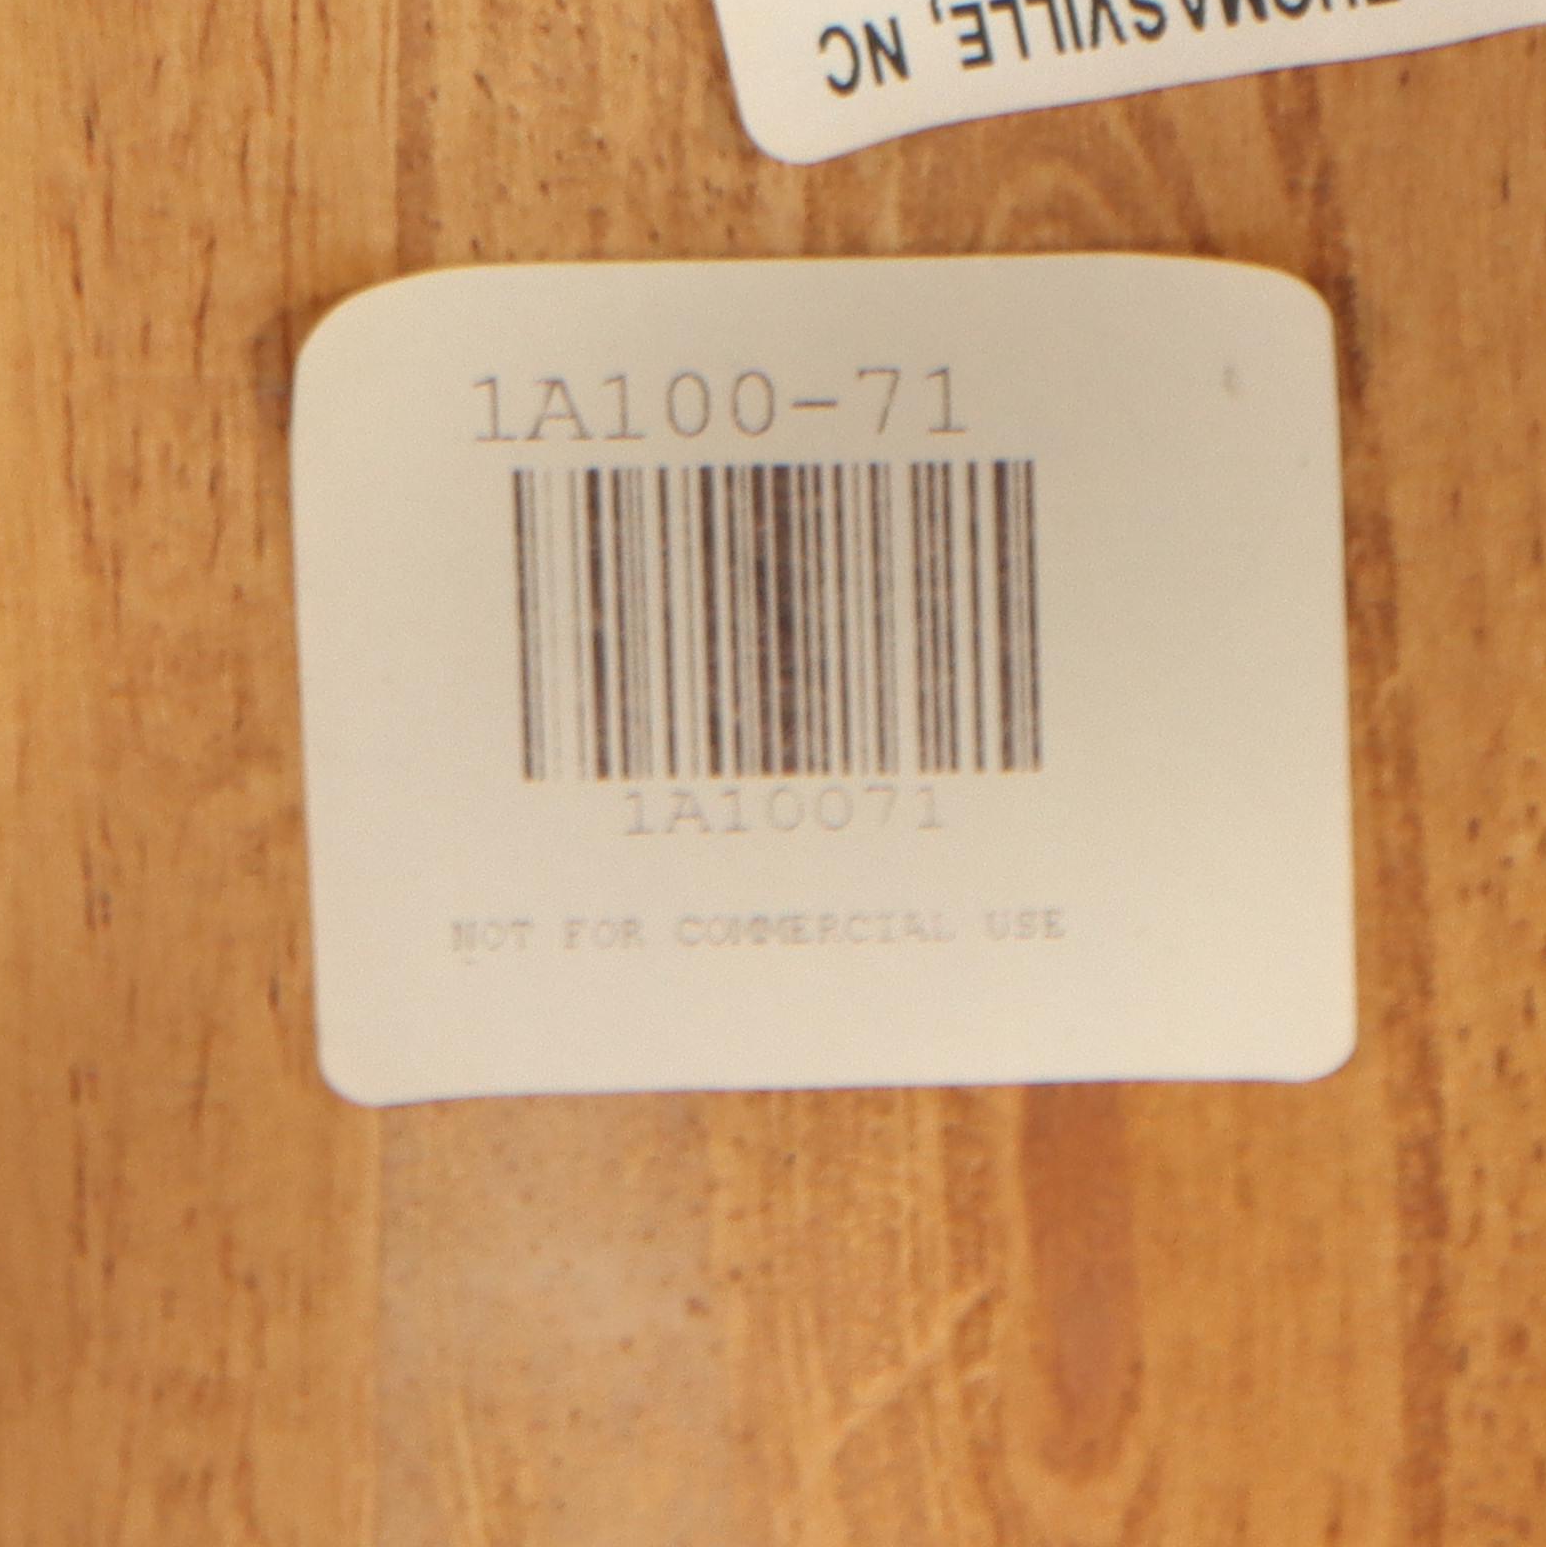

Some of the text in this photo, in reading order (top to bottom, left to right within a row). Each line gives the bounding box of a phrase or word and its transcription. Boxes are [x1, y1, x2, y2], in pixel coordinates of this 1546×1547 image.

[817, 17, 909, 97] NC
[471, 365, 970, 442] 1A100-71
[623, 783, 945, 837] 1A10071
[451, 907, 1066, 955] NOT FOR COMMERCIAL USE
